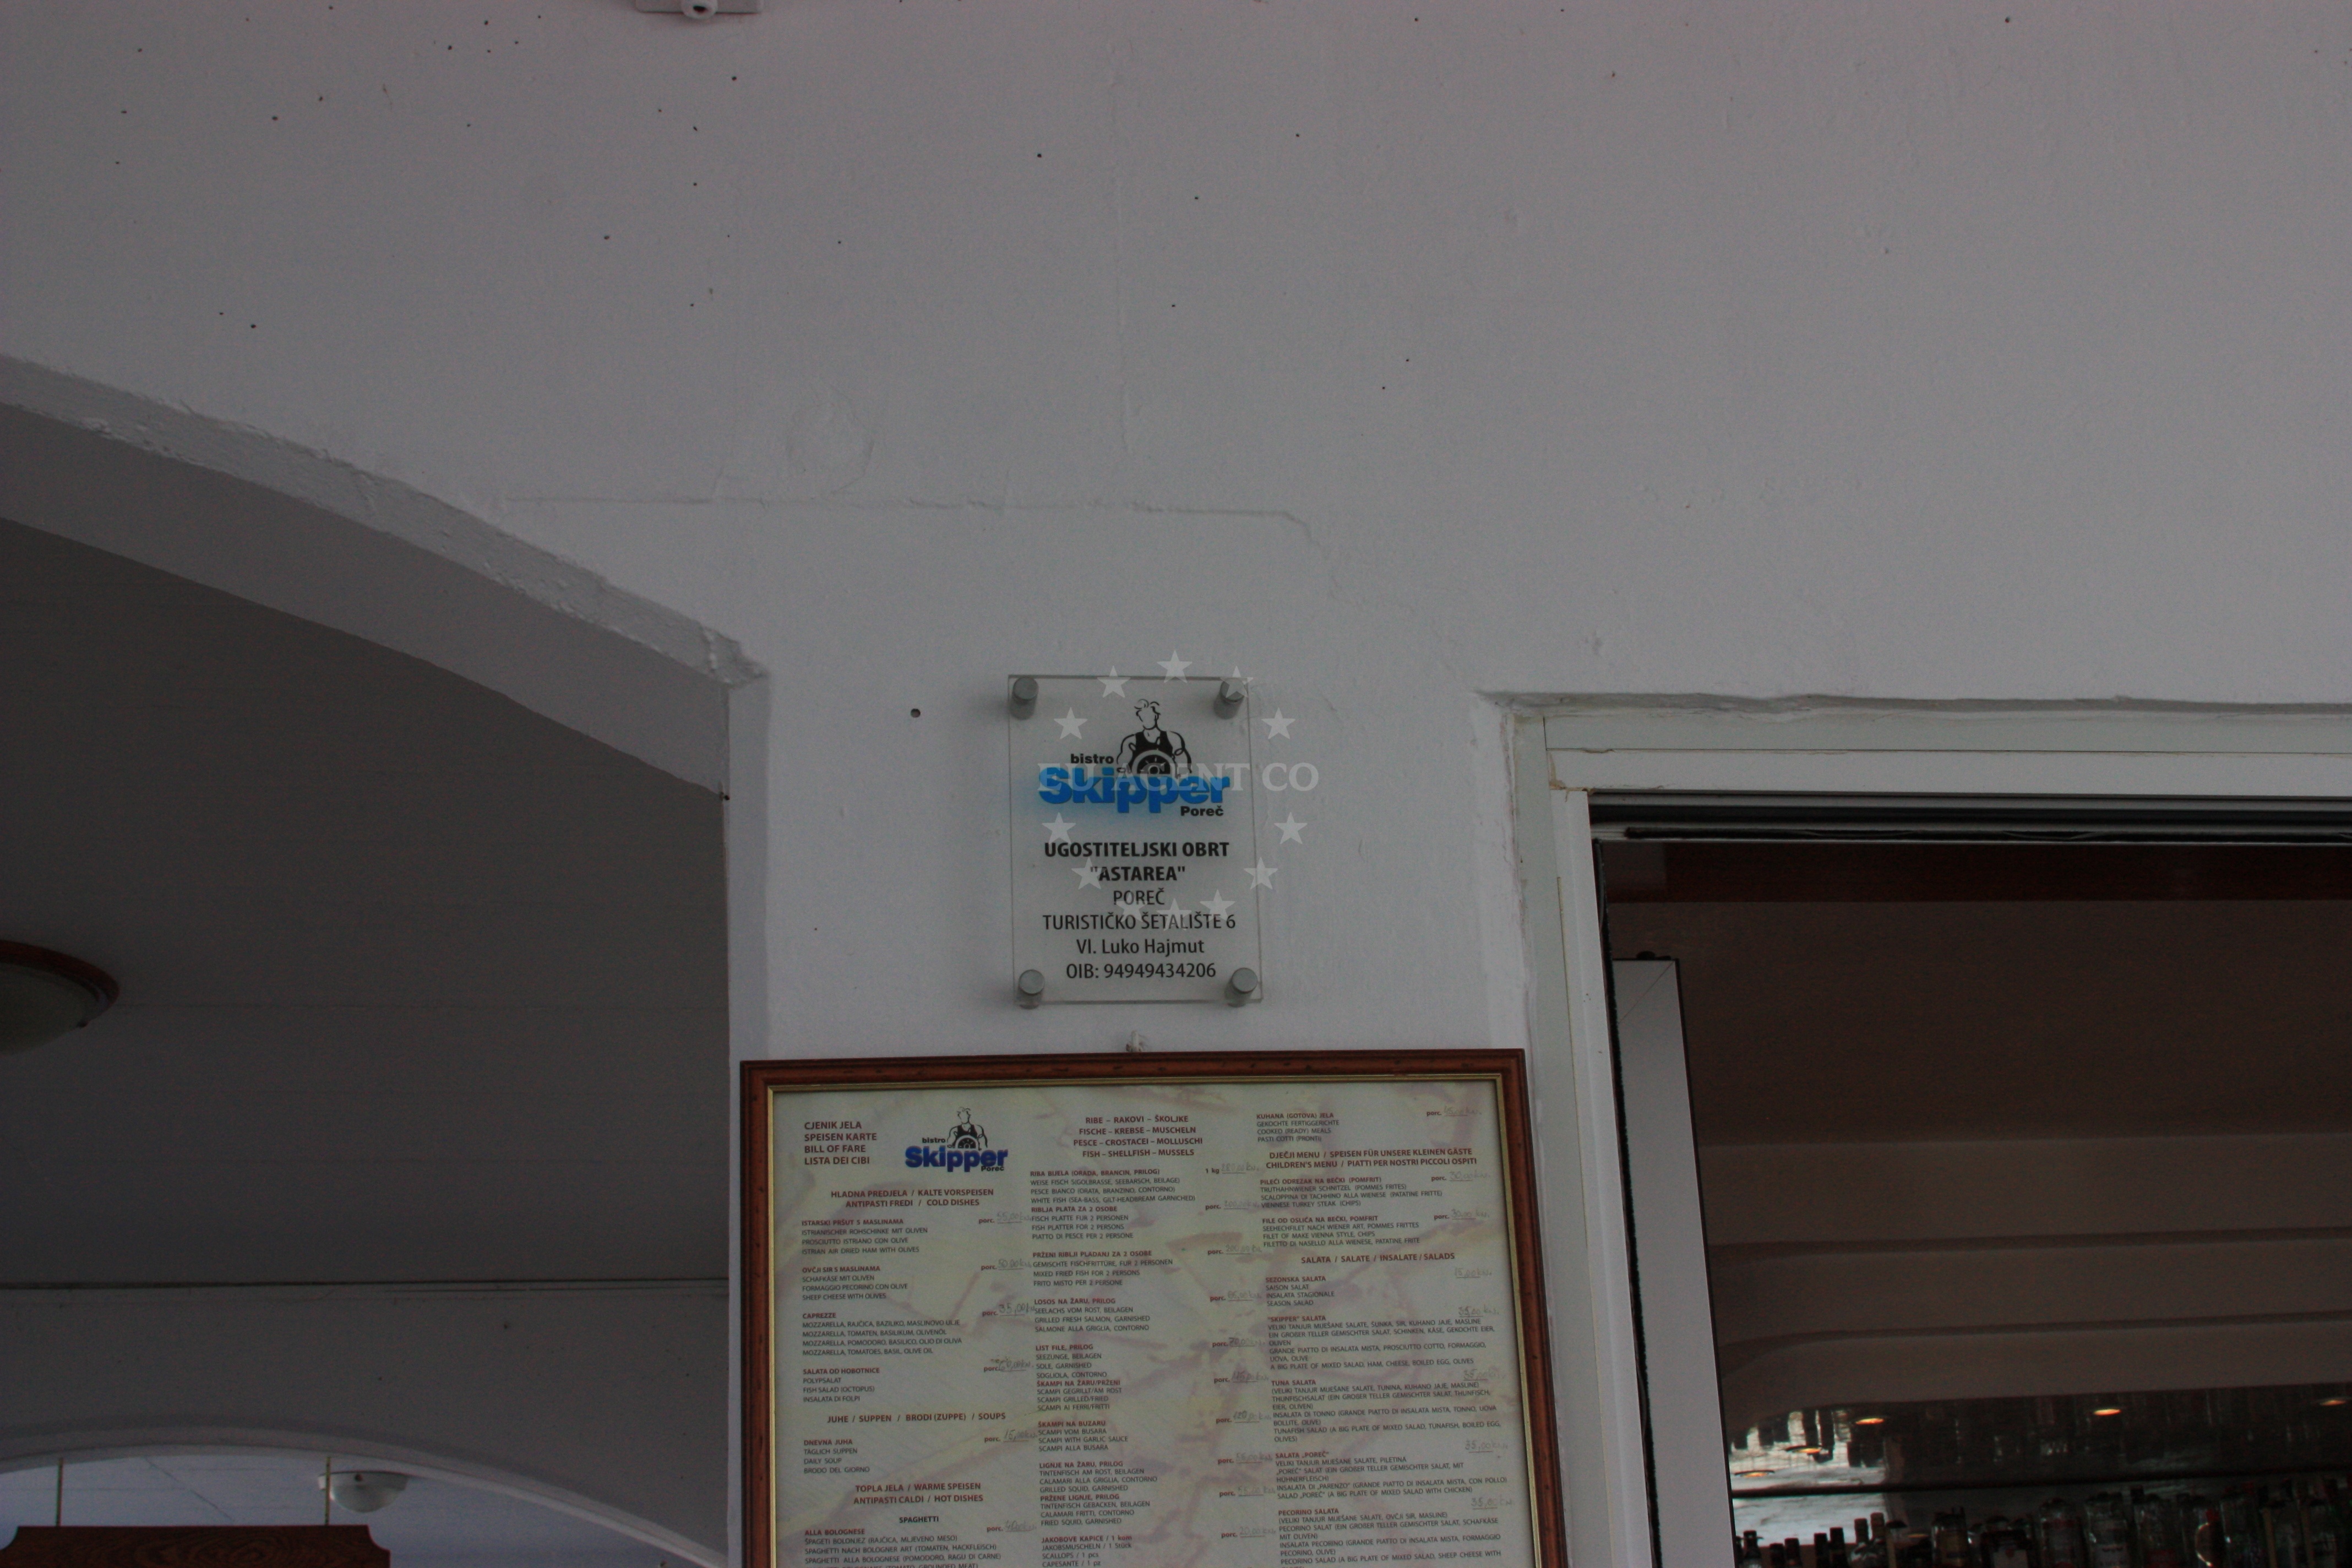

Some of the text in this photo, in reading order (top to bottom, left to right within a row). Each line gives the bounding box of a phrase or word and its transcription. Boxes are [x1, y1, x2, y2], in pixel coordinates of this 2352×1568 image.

[1070, 754, 1114, 764] bistro
[1039, 766, 1230, 814] Skipper
[1180, 805, 1224, 816] Poreč
[1044, 842, 1229, 857] UGOSTITELJSKI OBRT
[1113, 886, 1165, 905] POREČ
[1043, 911, 1235, 929] TURISTIČKO ŠETALIŠTE 6
[1101, 939, 1139, 954] Luko
[1144, 939, 1204, 957] Hajmut
[1066, 962, 1216, 978] OIB: 94949434206
[1154, 1113, 1189, 1123] ŠKOLJKE
[804, 1121, 862, 1130] CJENIK JELA
[804, 1133, 877, 1141] SPEISEN KARTE
[1156, 1137, 1203, 1145] MOLLUSCHI
[804, 1144, 865, 1153] BILL OF FARE
[1108, 1149, 1151, 1157] SHELLFISH
[1268, 1150, 1295, 1159] DJEČJI
[1363, 1148, 1379, 1157] FÜR
[1447, 1146, 1472, 1155] GÄSTE
[804, 1156, 870, 1165] LISTA DEI CIBI
[905, 1145, 1009, 1173] Skipper
[858, 1414, 892, 1422] SUPPEN
[933, 1413, 966, 1422] (ZUPPE)
[913, 1483, 945, 1491] WARME
[947, 1482, 981, 1490] SPEISEN
[853, 1496, 897, 1504] ANTIPASTI
